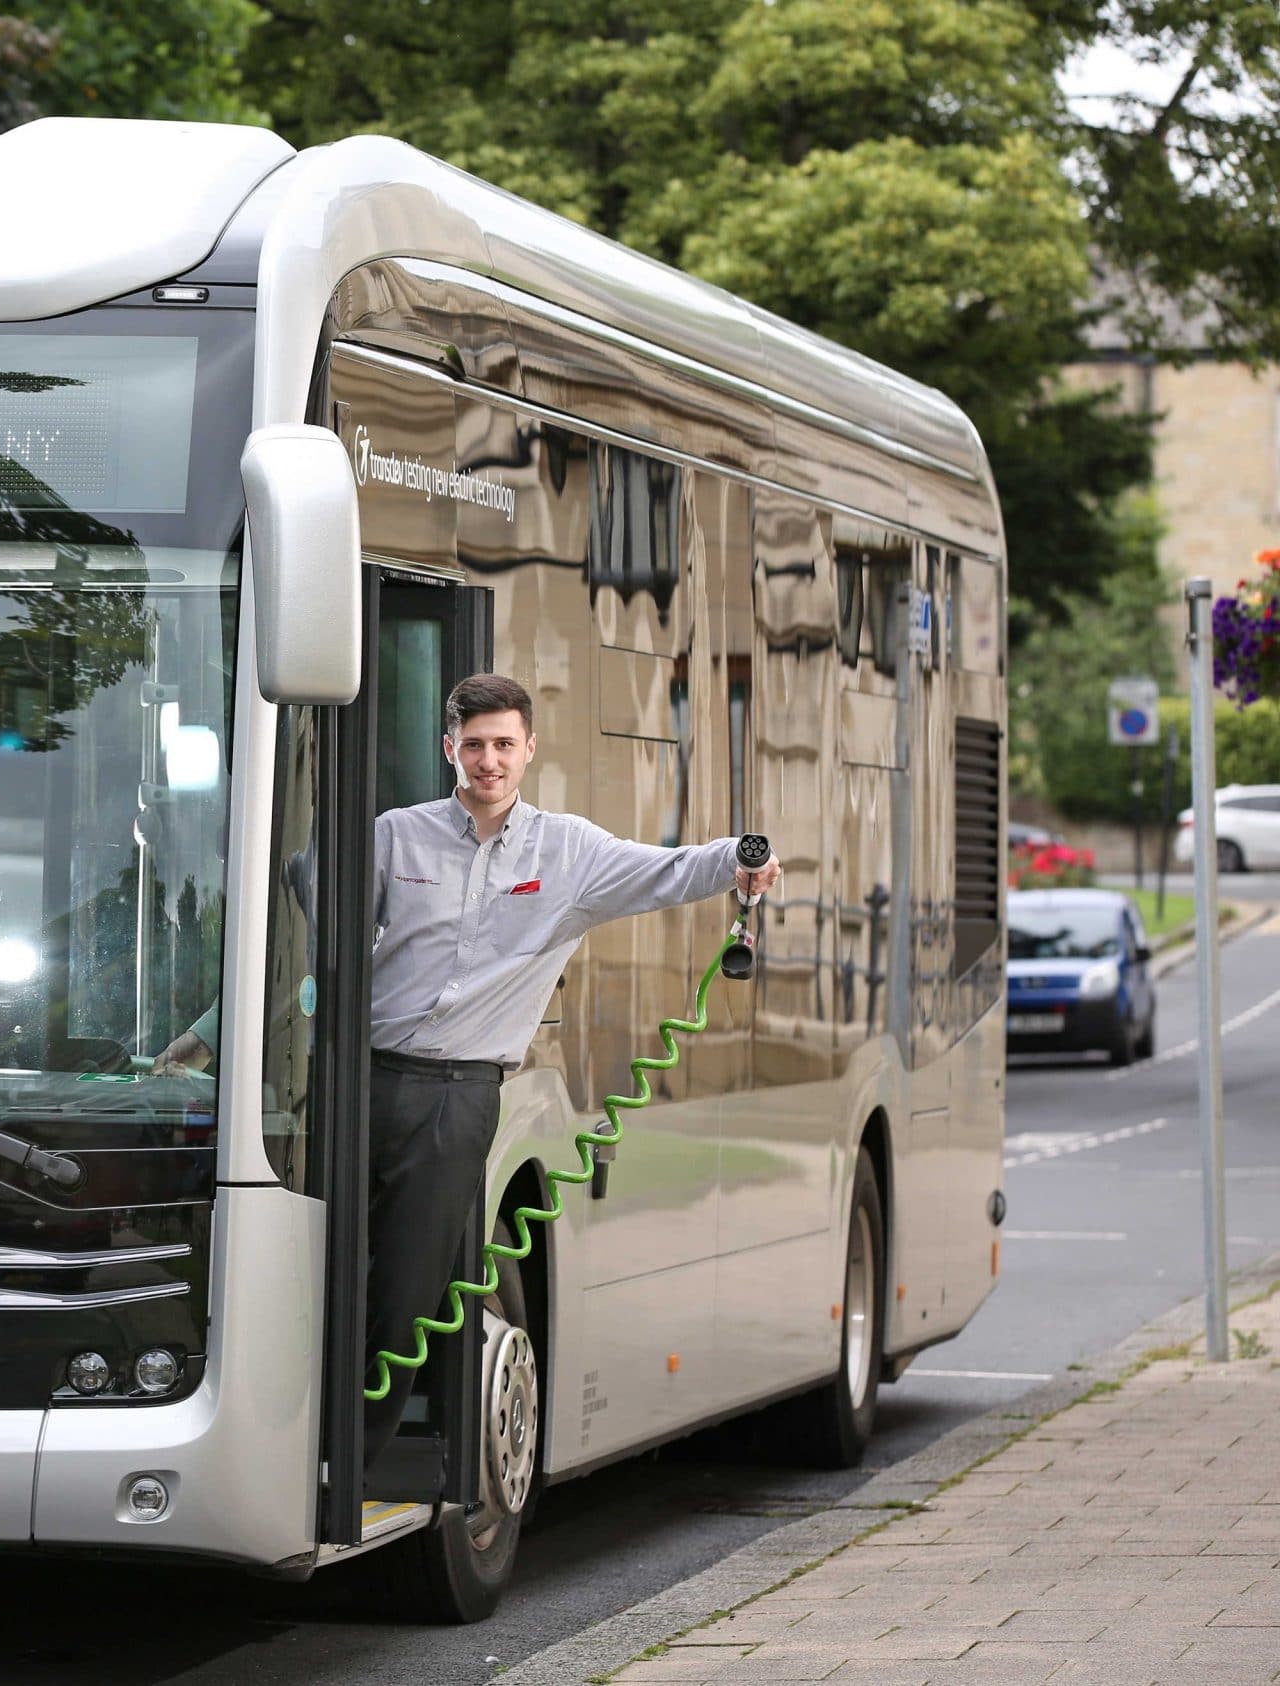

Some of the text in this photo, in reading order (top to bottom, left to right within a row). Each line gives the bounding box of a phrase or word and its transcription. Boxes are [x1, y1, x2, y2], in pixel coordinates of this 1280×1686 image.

[369, 447, 516, 523] transdev testing new electric technology
